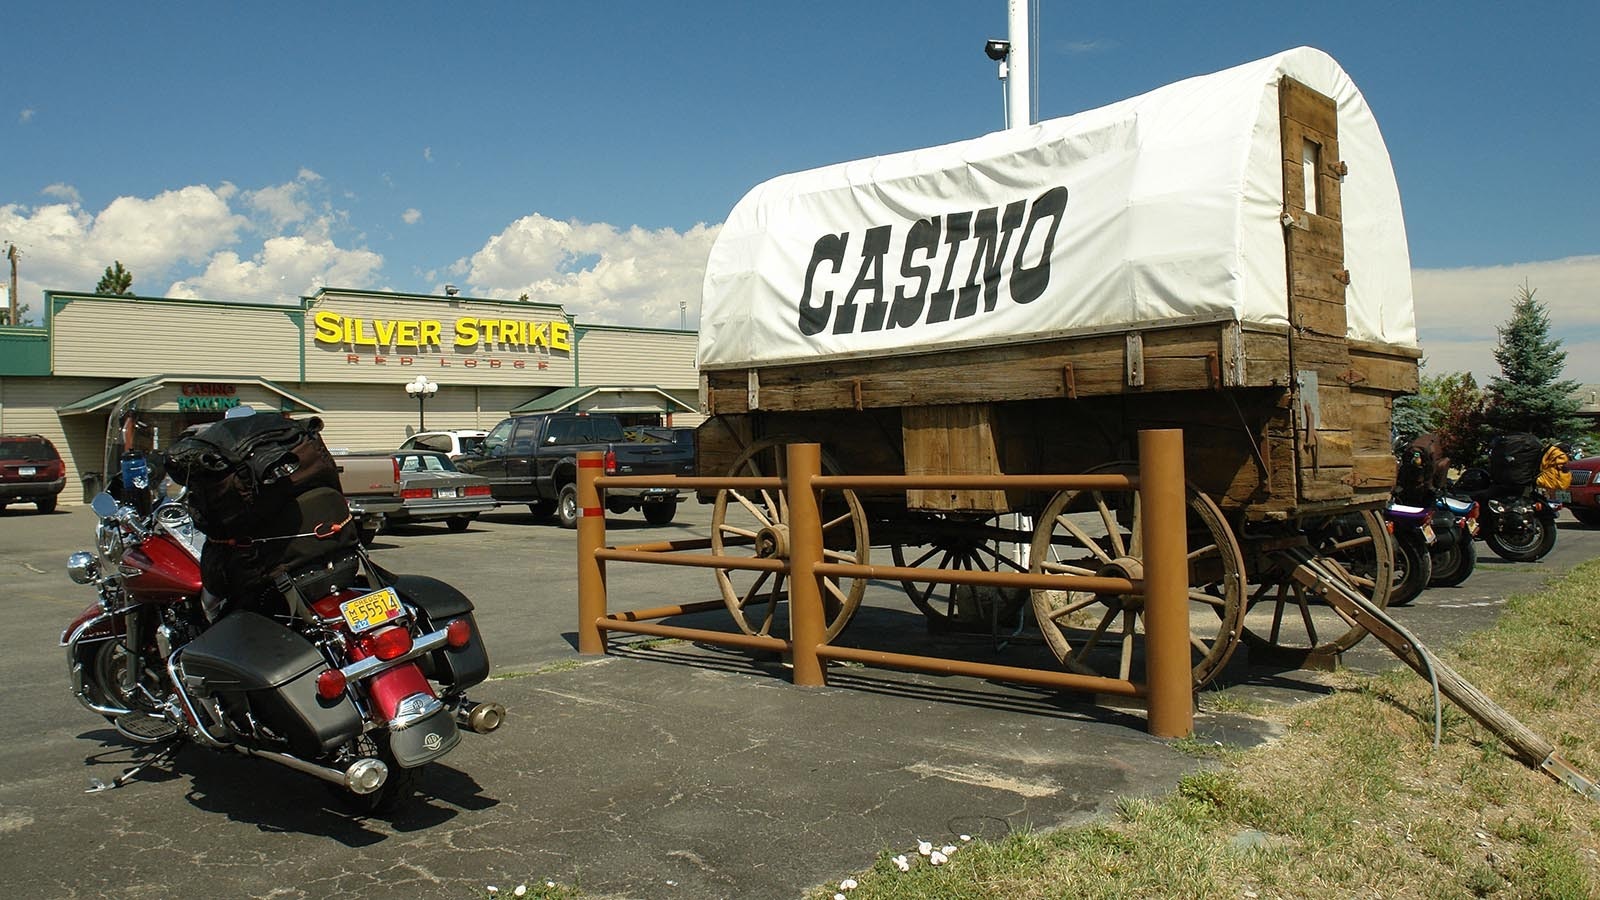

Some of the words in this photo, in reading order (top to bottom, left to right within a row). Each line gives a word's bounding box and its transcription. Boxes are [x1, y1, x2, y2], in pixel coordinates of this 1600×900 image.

[798, 186, 1068, 336] CASINO
[314, 311, 442, 346] SILVER
[455, 317, 571, 351] STRIKE
[346, 354, 413, 366] RED
[183, 384, 236, 396] CASINO
[358, 596, 398, 620] 55514
